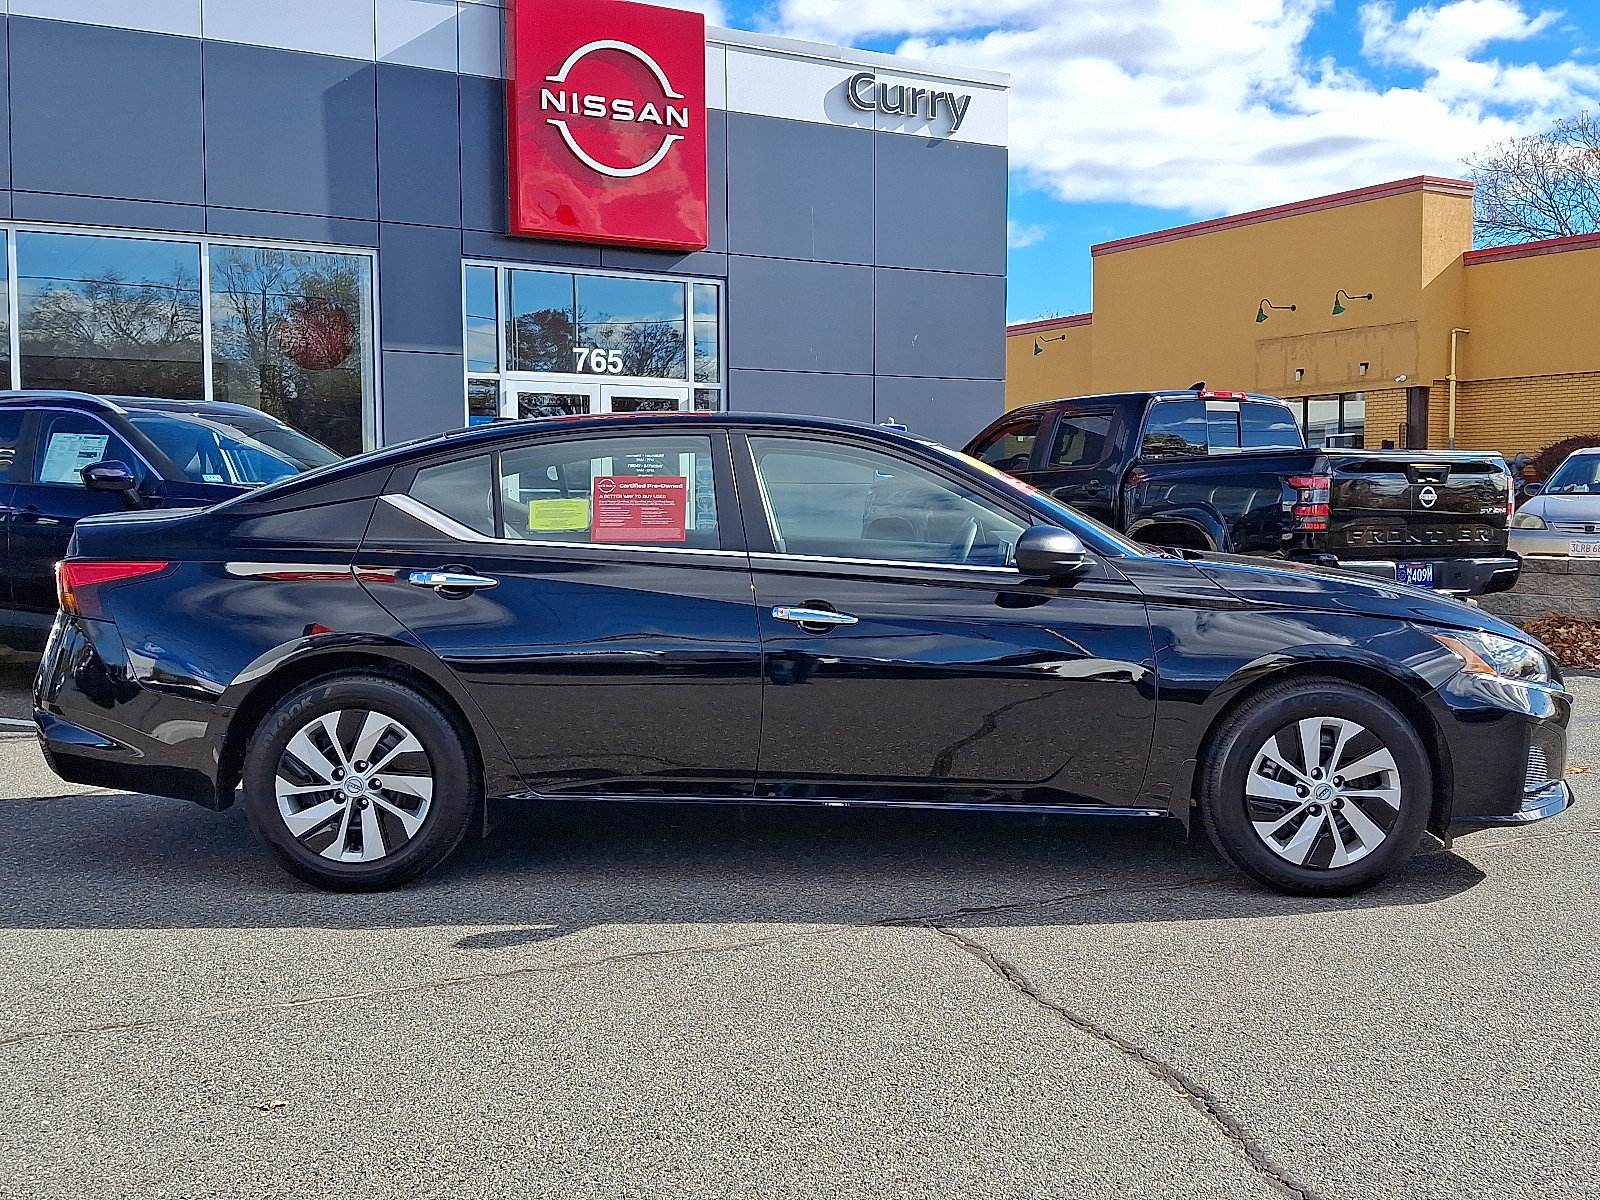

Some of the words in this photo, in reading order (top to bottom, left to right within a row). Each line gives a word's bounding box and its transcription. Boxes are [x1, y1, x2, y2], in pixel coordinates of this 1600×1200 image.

[541, 88, 689, 128] NISSAN
[847, 72, 972, 133] Curry
[572, 347, 624, 374] 765
[1571, 543, 1591, 553] 3LRB
